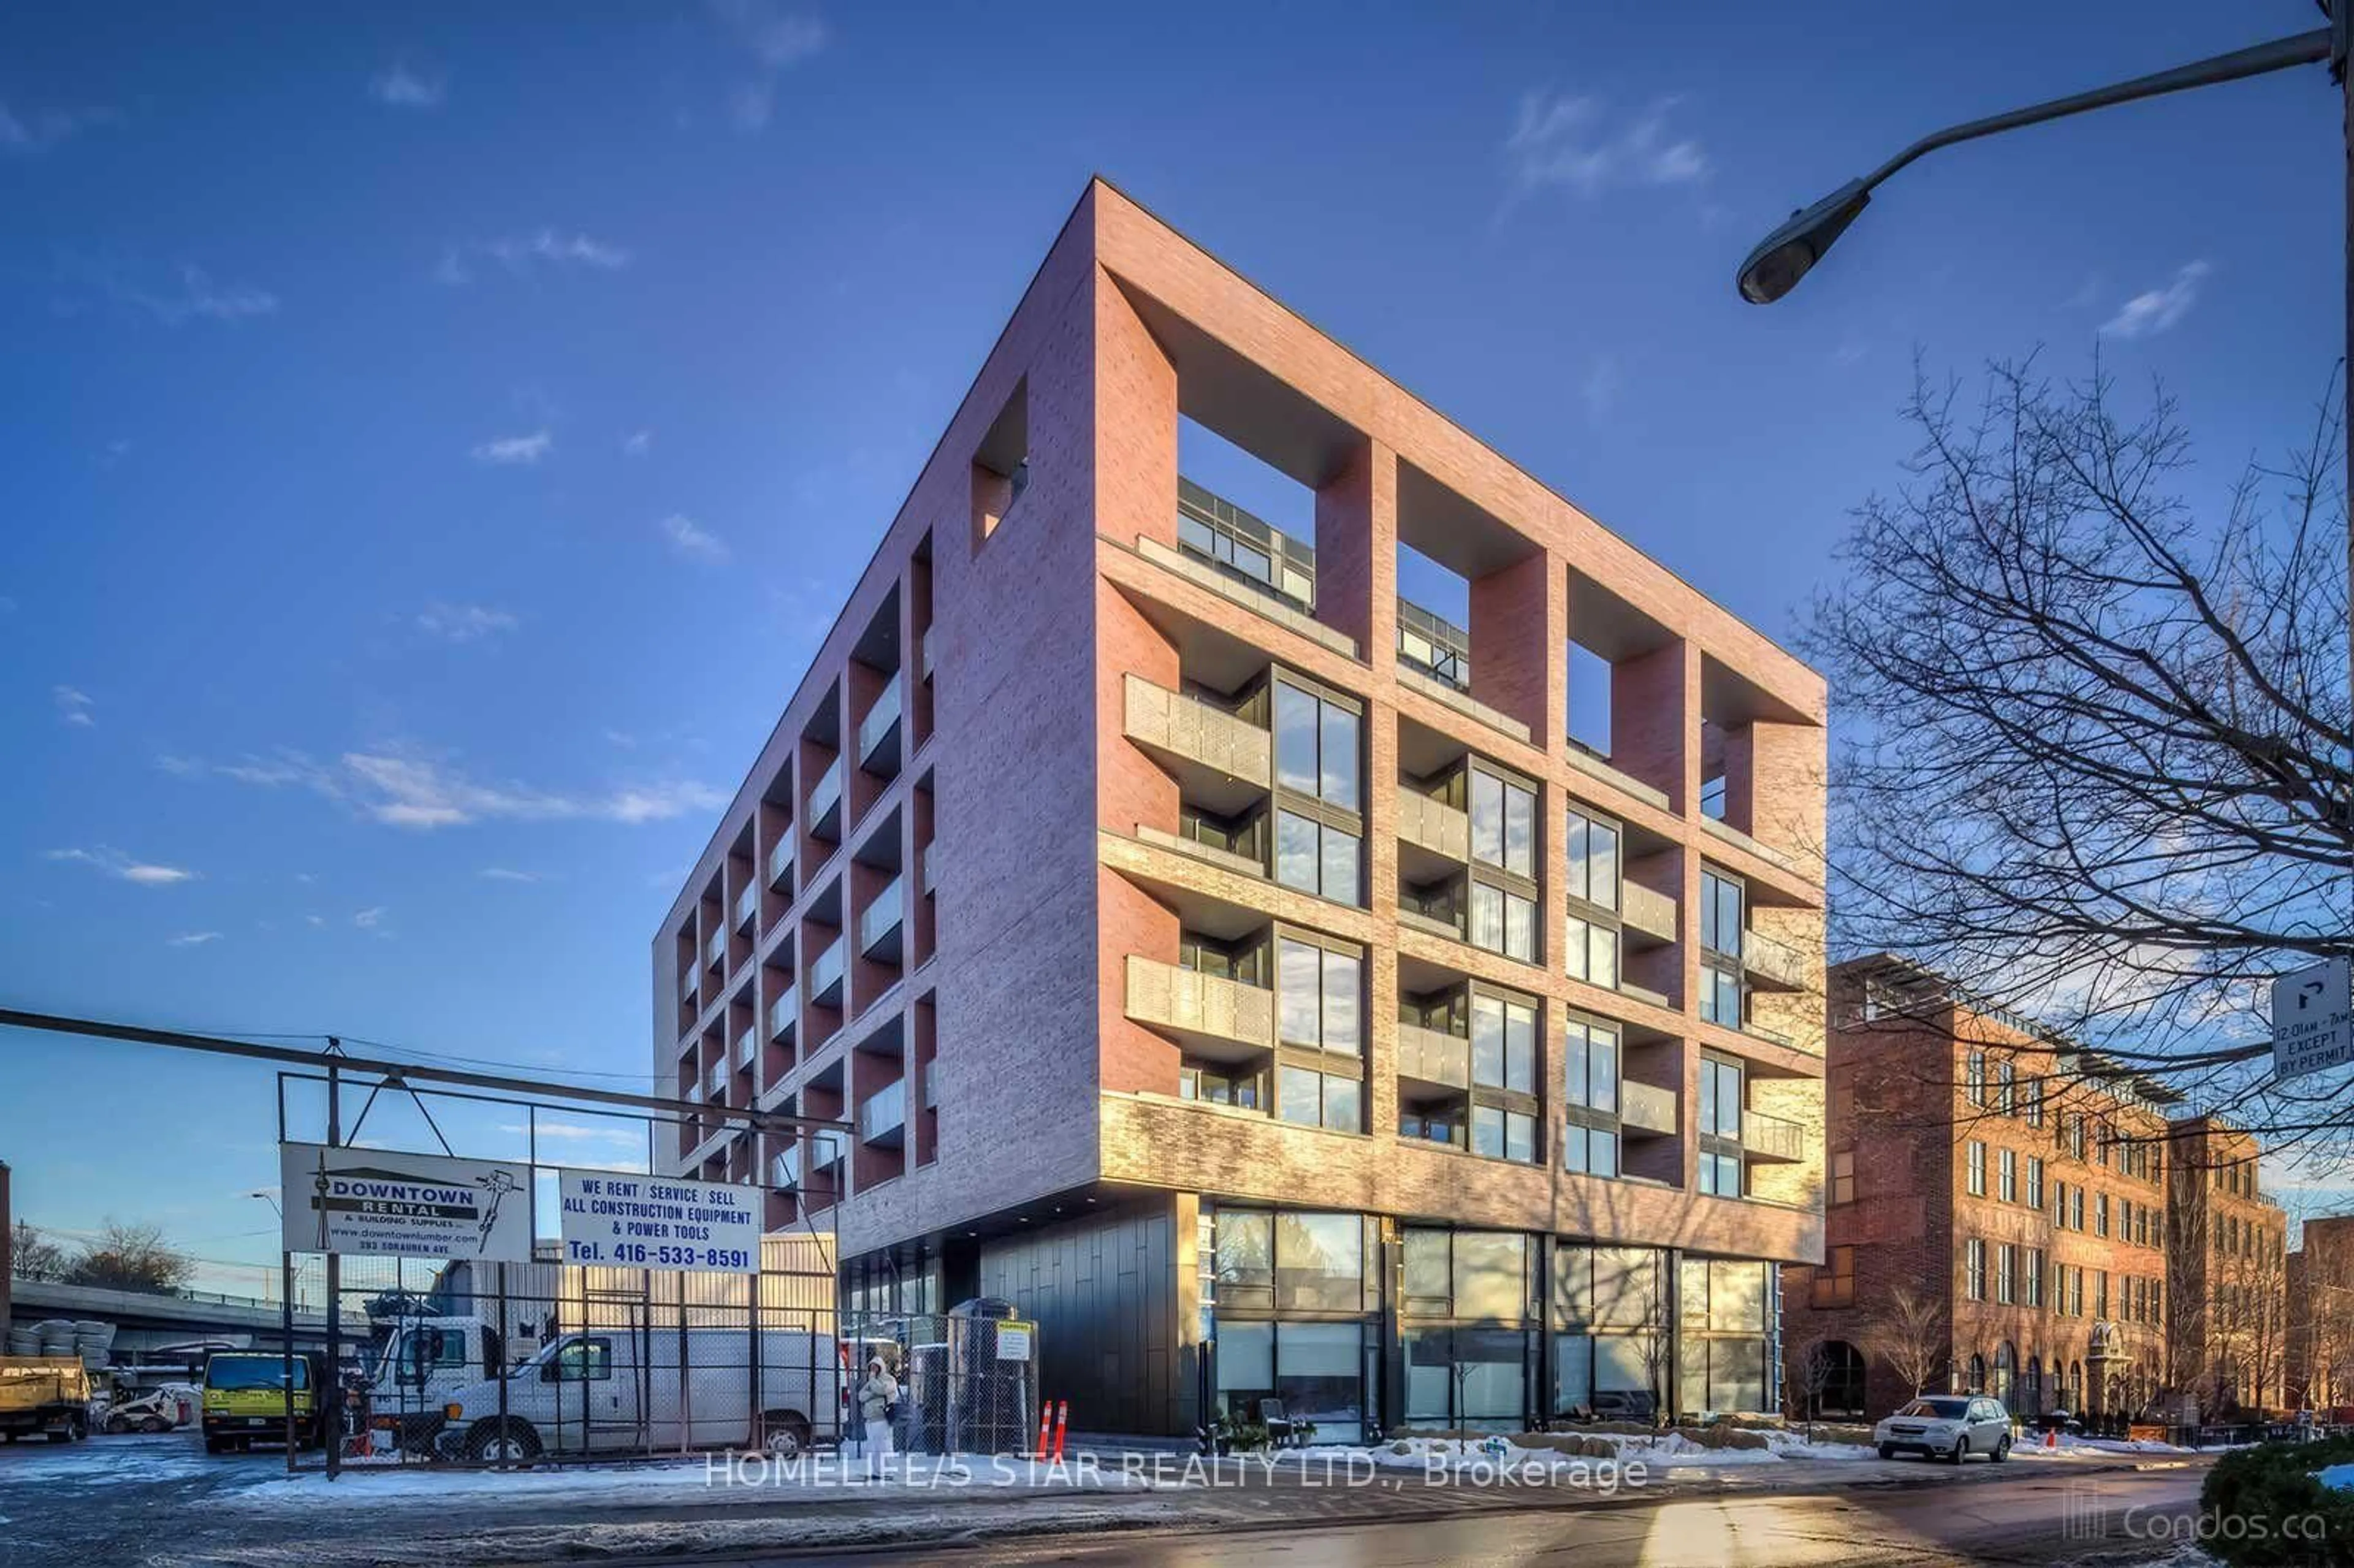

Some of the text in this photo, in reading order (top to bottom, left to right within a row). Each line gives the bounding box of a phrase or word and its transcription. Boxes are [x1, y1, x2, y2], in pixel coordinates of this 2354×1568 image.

[2330, 1012, 2348, 1026] 7AM
[2288, 1030, 2337, 1055] EXCEPT
[2280, 1046, 2347, 1073] BY PERMIT
[333, 1181, 473, 1205] DOWNTOWN
[582, 1179, 601, 1195] WE
[608, 1182, 638, 1198] RENT
[650, 1185, 698, 1203] SERVICE
[709, 1190, 735, 1206] SELL
[362, 1201, 440, 1217] RENTAL
[564, 1198, 751, 1225] ALL CONSTRUCTION EQUIPMENT
[358, 1215, 406, 1225] BUILDING
[411, 1218, 453, 1228] SUPPLIES
[612, 1221, 709, 1241] & POWER TOOLS
[331, 1228, 478, 1243] www.downtownlumber.com
[569, 1240, 748, 1268] Tel. 416-533-8591
